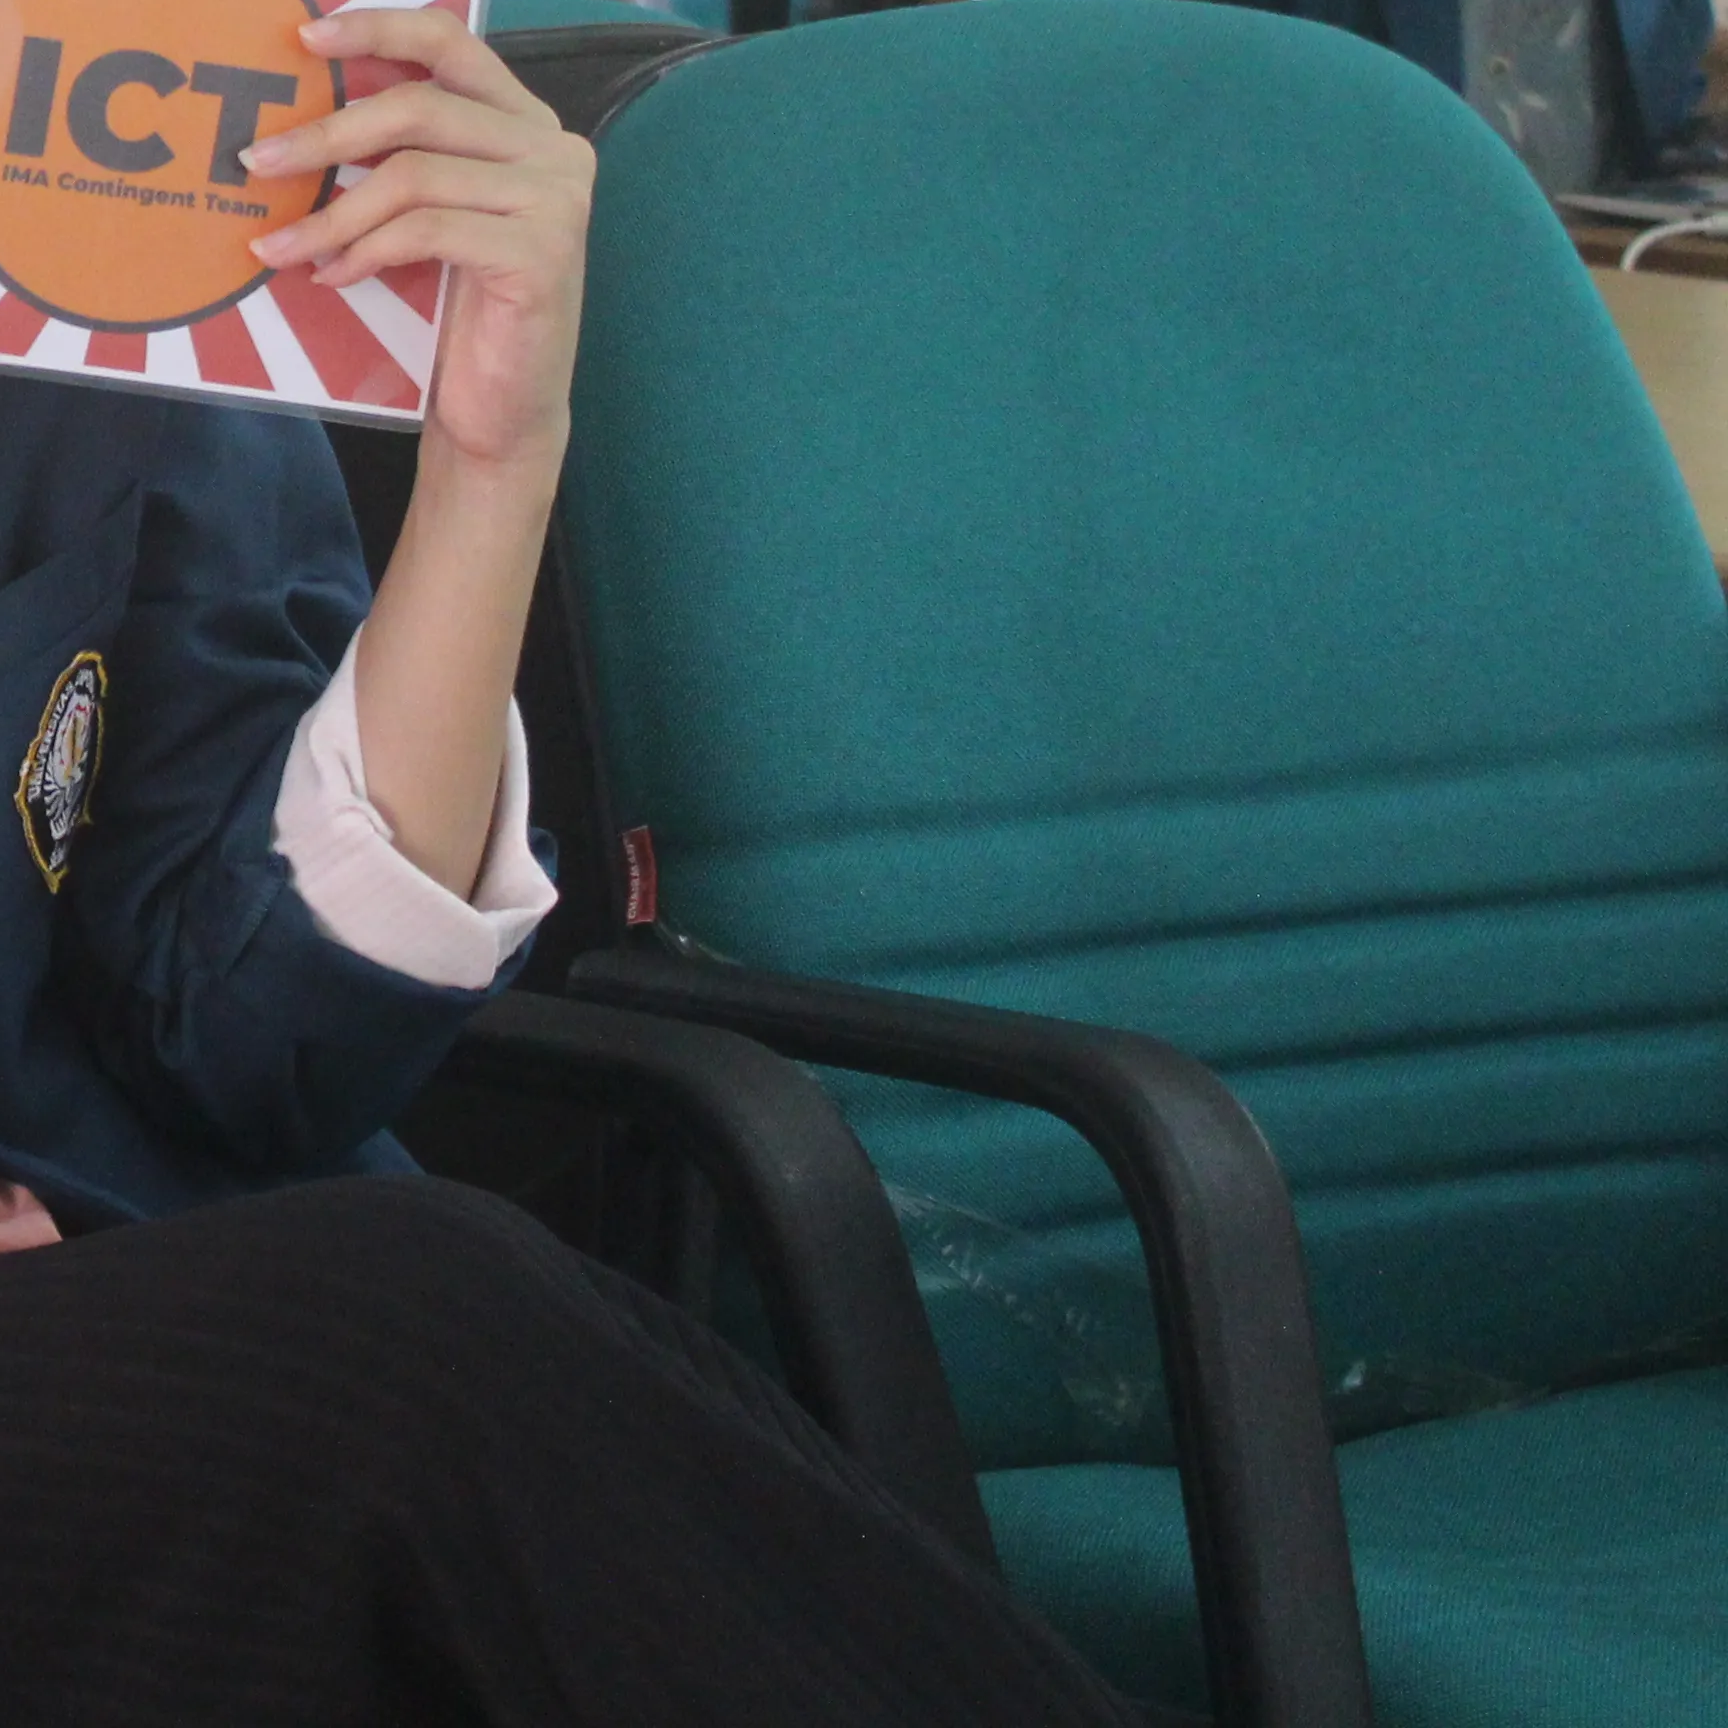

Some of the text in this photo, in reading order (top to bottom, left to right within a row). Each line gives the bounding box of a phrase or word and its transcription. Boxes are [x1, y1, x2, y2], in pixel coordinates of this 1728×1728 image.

[5, 36, 299, 189] ICT
[2, 164, 269, 218] IMA Contingent Team
